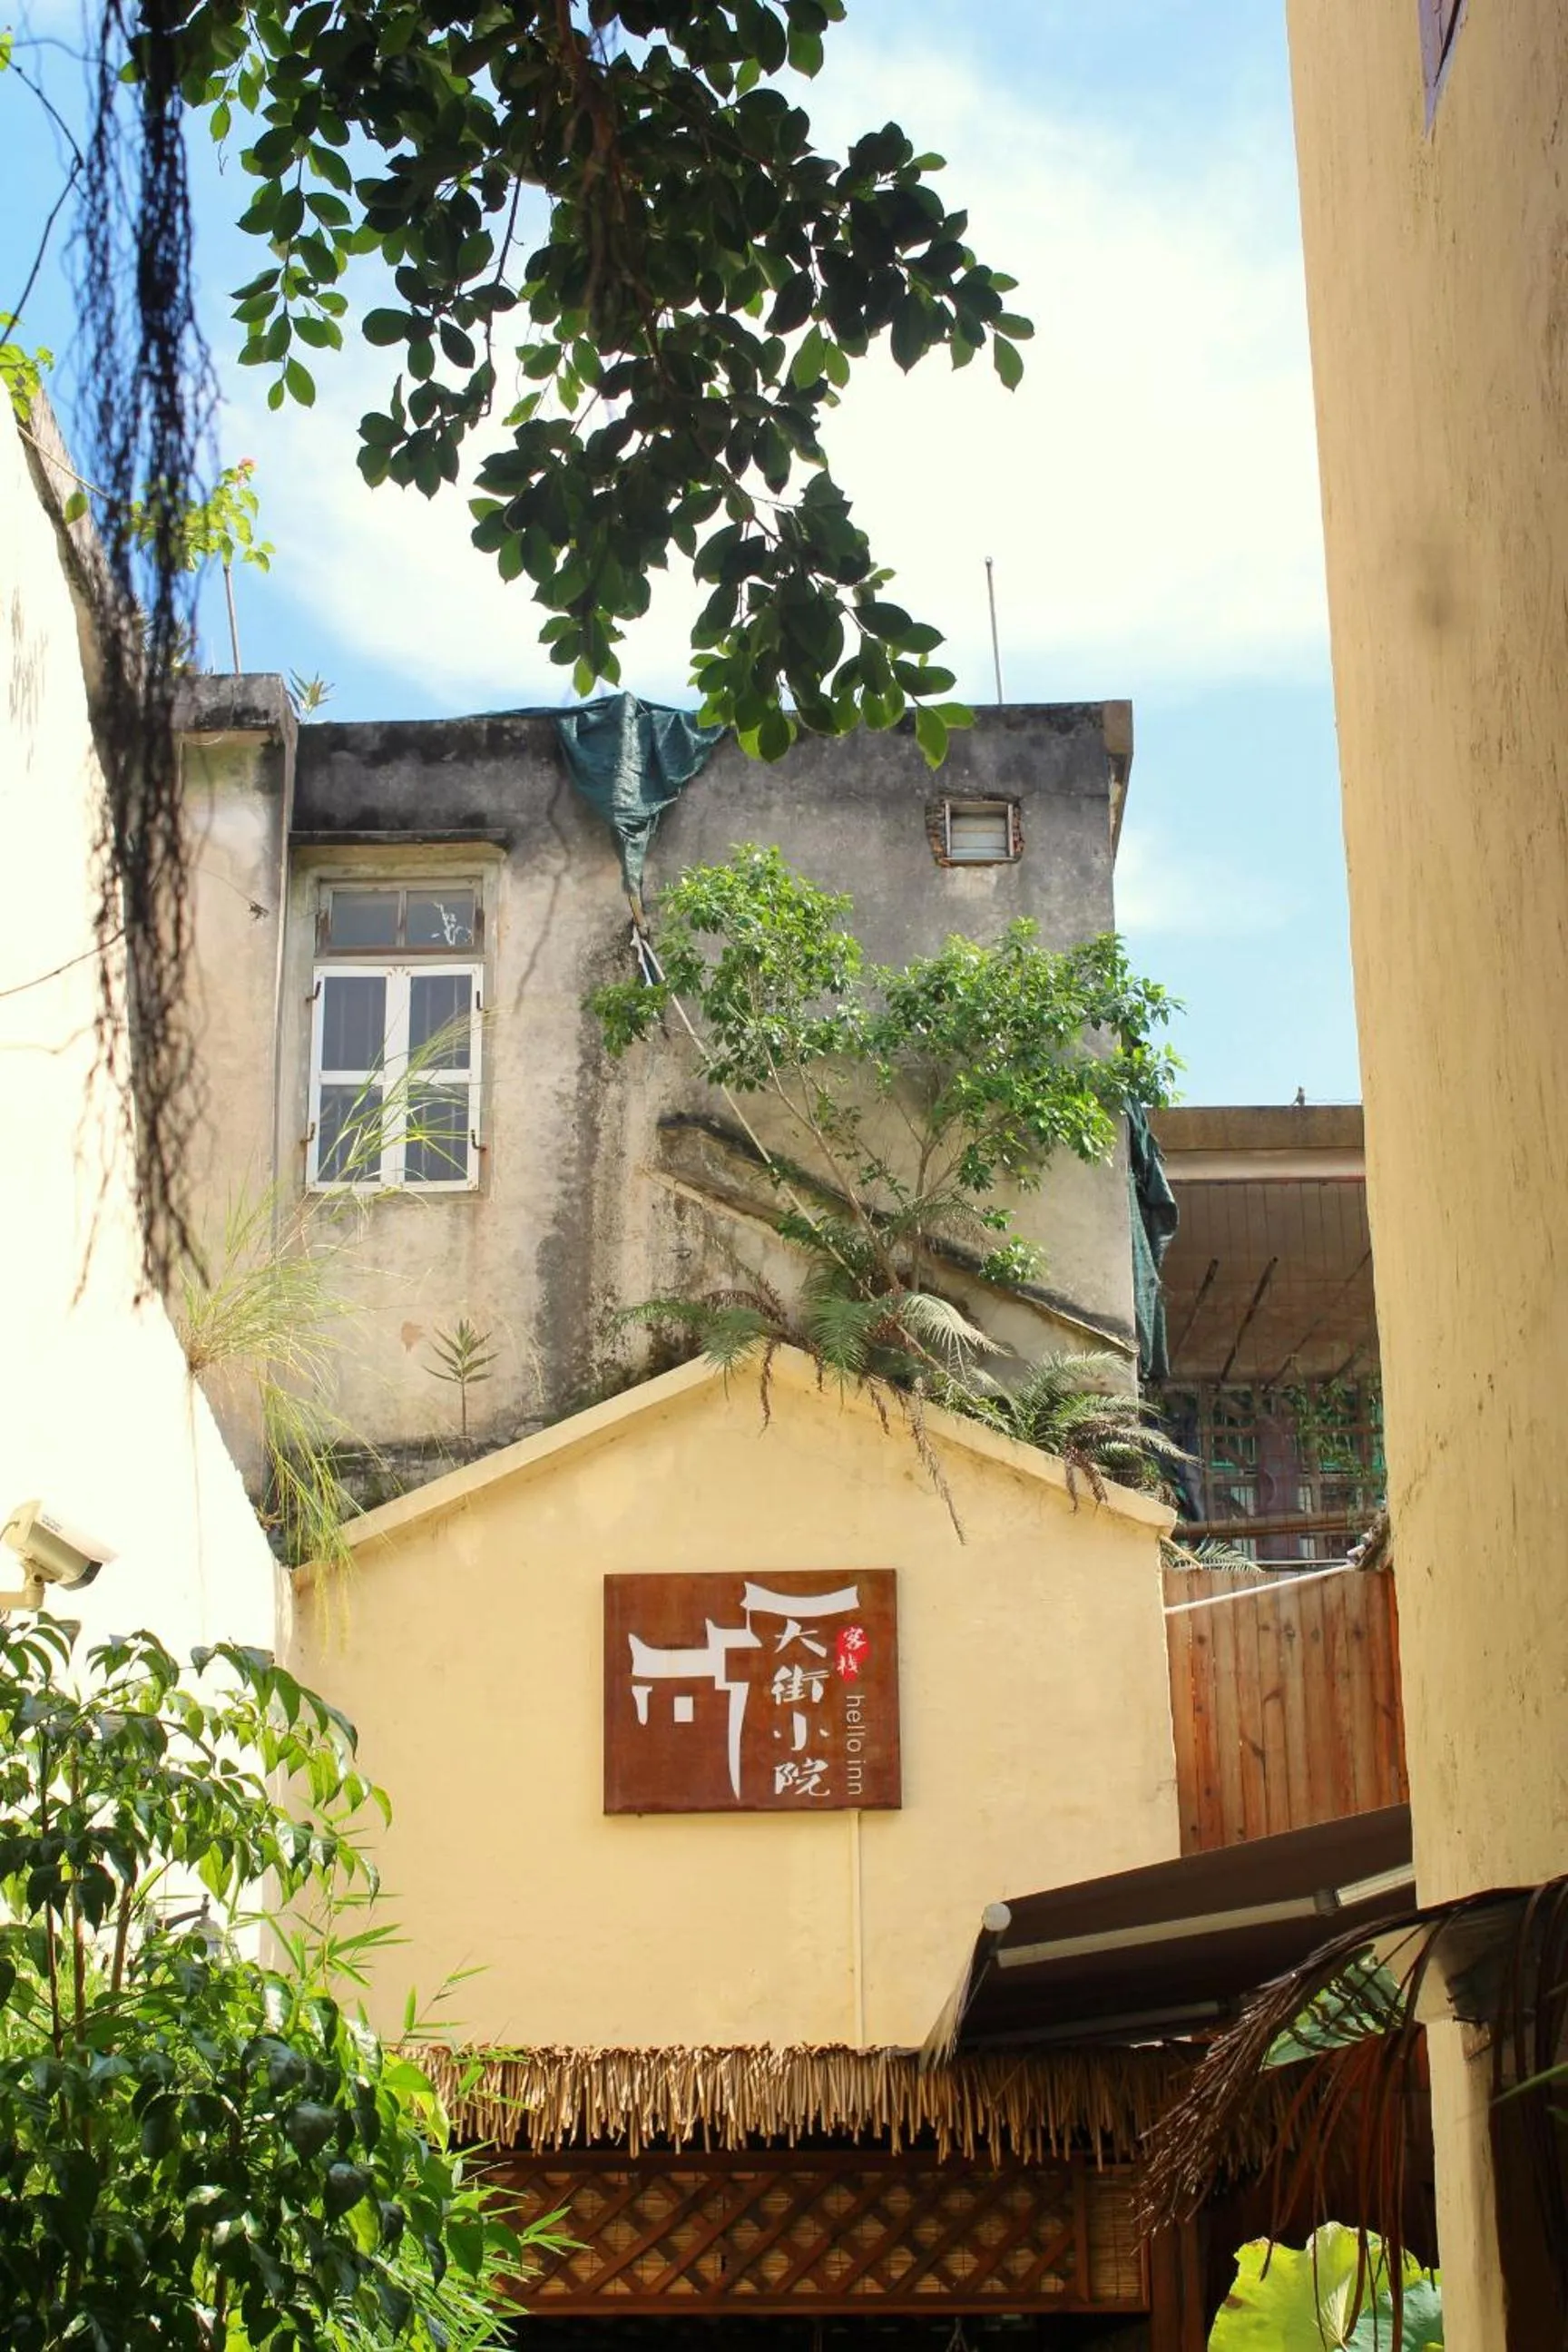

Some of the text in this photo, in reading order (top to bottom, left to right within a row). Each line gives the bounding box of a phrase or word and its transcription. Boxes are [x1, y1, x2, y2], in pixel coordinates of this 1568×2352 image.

[772, 1618, 829, 1797] 大街小院
[846, 1695, 866, 1795] hello inn
